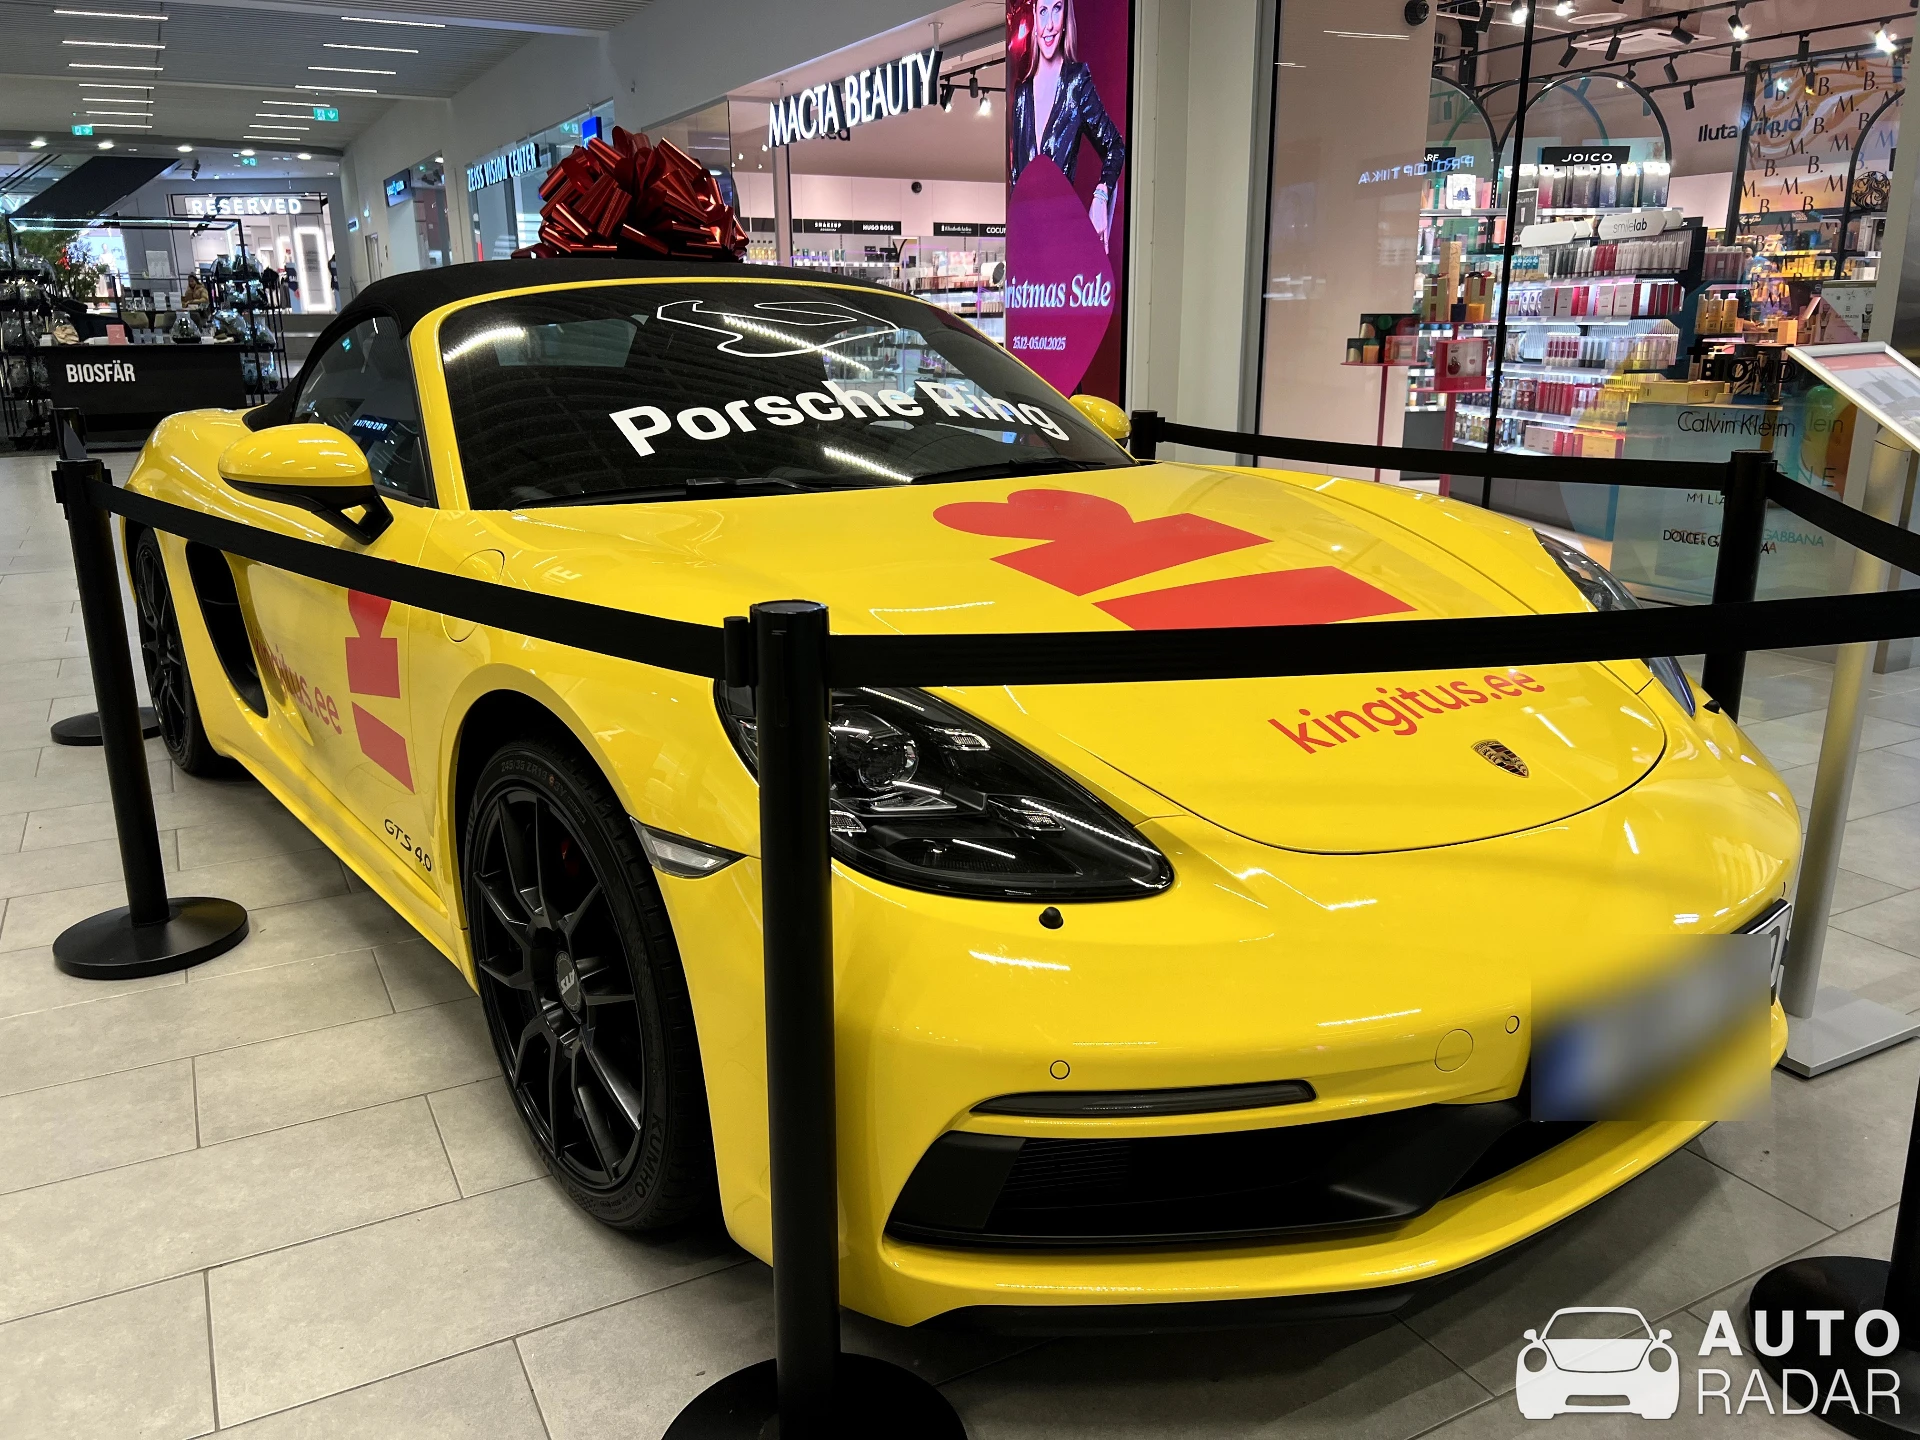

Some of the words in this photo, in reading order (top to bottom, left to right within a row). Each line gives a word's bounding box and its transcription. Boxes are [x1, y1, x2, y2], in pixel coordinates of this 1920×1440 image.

[769, 82, 840, 148] MACTA
[845, 48, 935, 128] BEAUTY
[467, 164, 484, 192] ZEISS
[484, 156, 508, 187] VISION
[508, 142, 537, 177] CENTER
[1561, 153, 1613, 163] JOICO
[191, 198, 302, 215] RESERVED
[1612, 218, 1648, 234] smilelab
[1070, 272, 1112, 307] Sale
[66, 360, 135, 383] BIOSFÄR
[609, 381, 924, 457] Porsche
[916, 380, 1070, 441] Ring
[1677, 411, 1735, 434] Calvin
[1267, 671, 1546, 755] kingitus.ee
[385, 819, 412, 851] GTS
[634, 1113, 664, 1199] KUMHO
